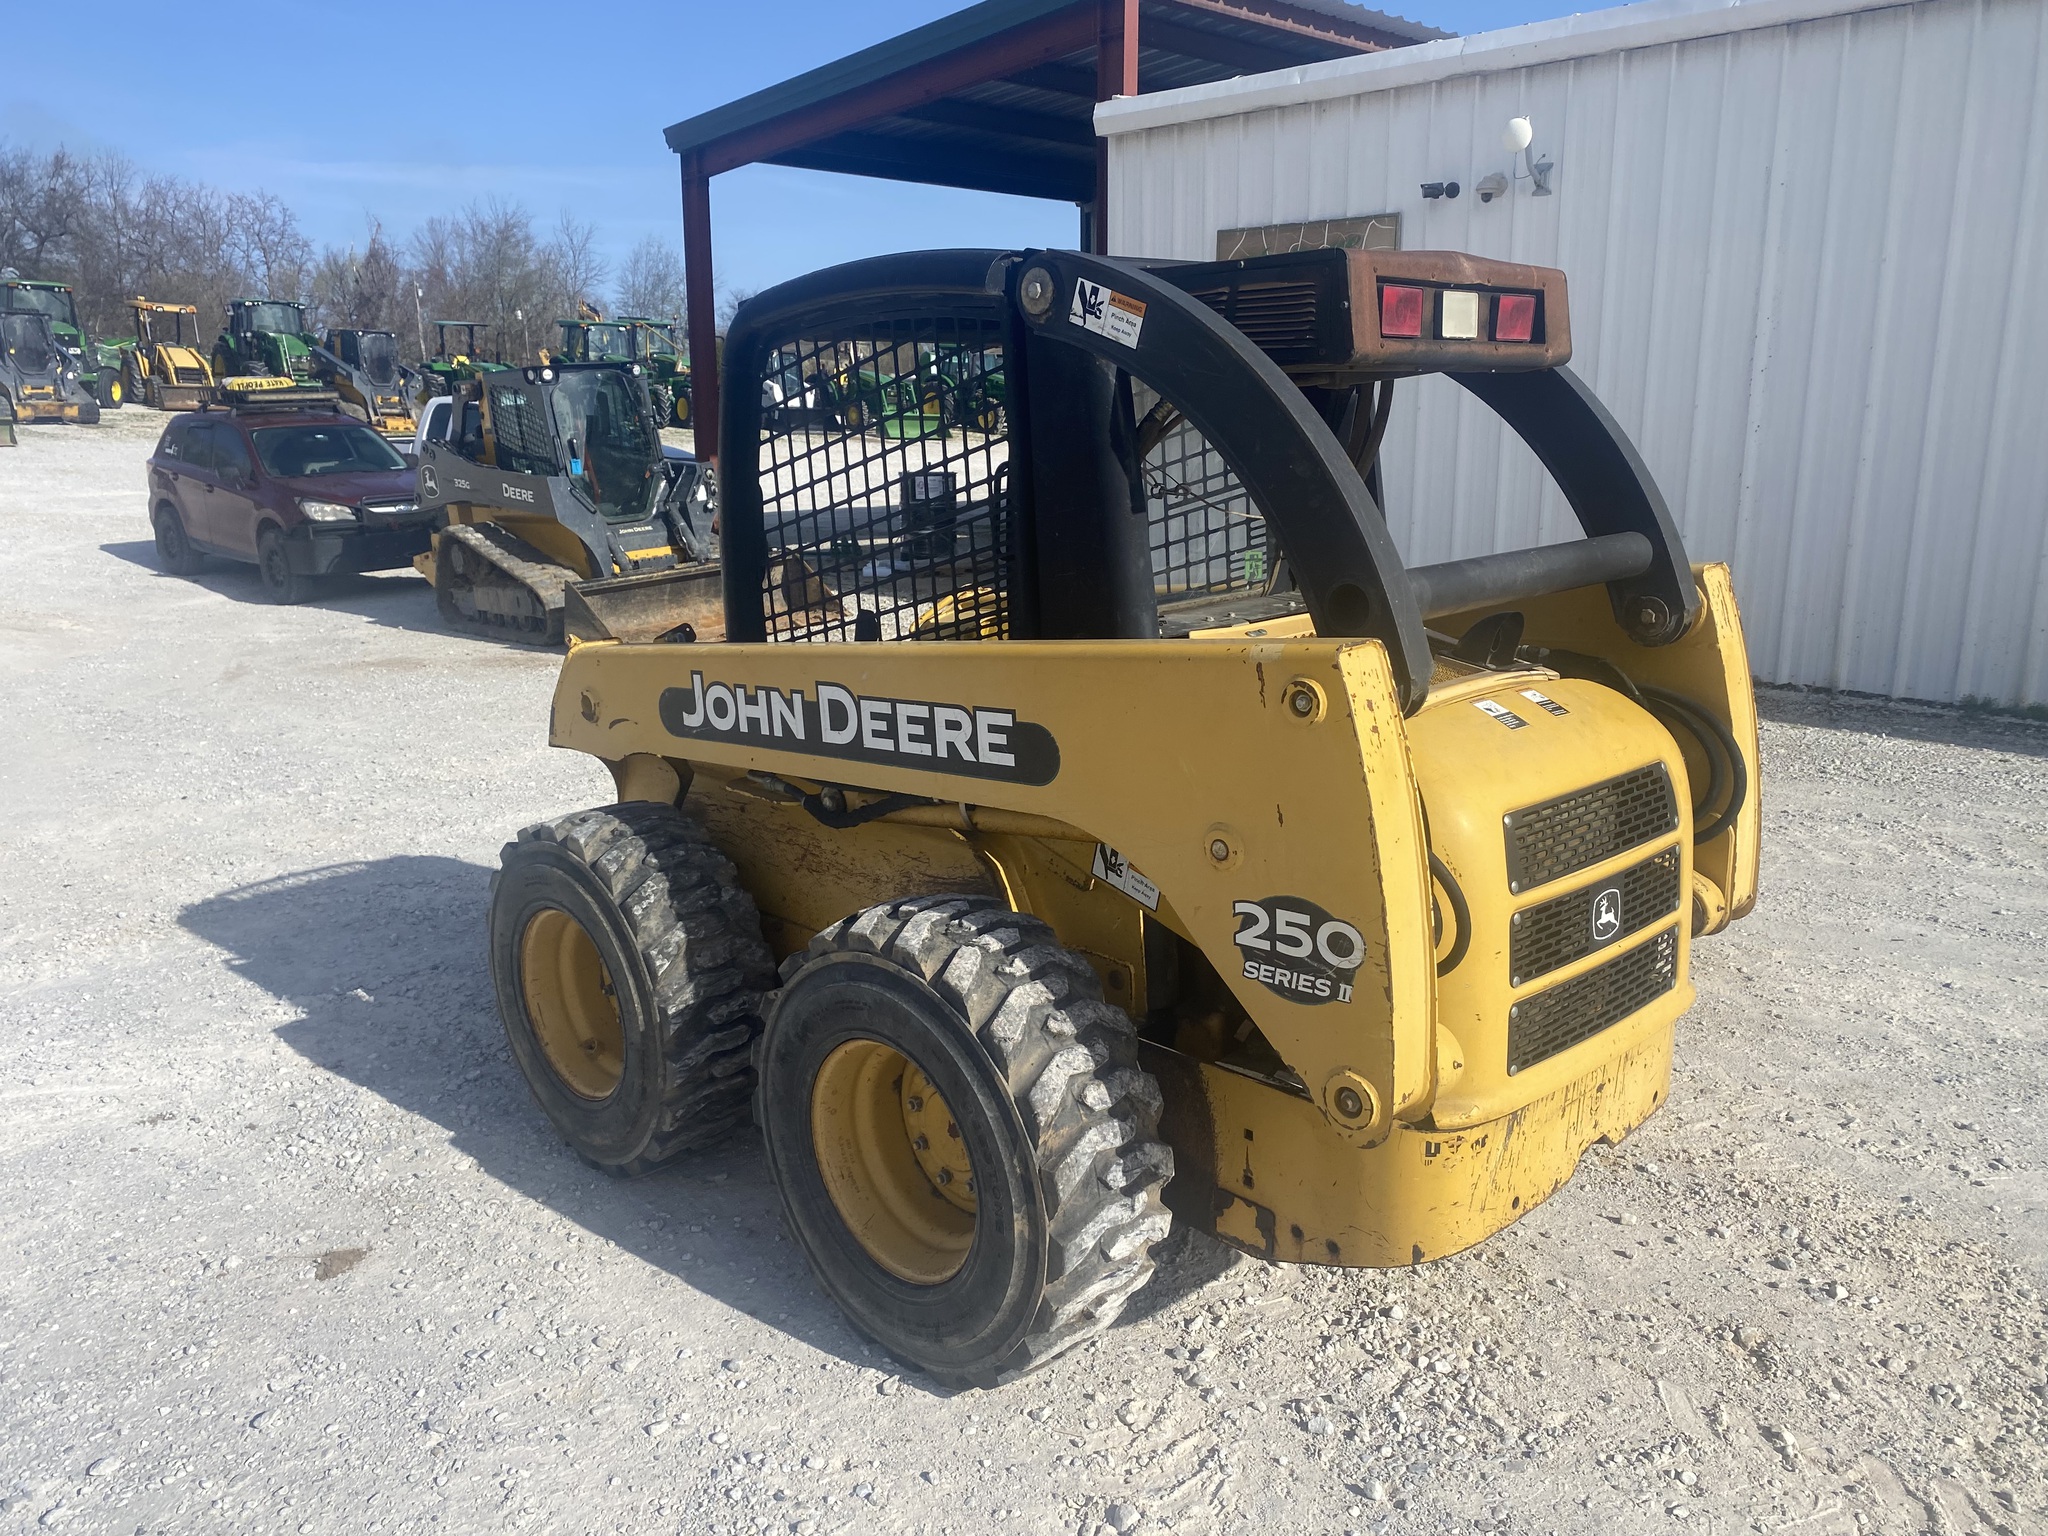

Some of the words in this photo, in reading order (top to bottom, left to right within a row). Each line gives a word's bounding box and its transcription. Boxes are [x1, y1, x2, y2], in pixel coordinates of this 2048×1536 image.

[1117, 298, 1142, 312] WARNING
[1111, 312, 1124, 323] Pinch
[1125, 317, 1137, 327] Area
[1111, 325, 1121, 333] Keep
[1121, 328, 1132, 337] Away
[453, 478, 470, 489] 325G
[502, 483, 535, 503] DEERE
[619, 527, 635, 535] JOHN
[634, 525, 654, 533] DEERE
[682, 673, 805, 740] JOHN
[816, 684, 1016, 767] DEERE
[1131, 874, 1144, 886] Pinch
[1144, 883, 1155, 892] Area
[1234, 902, 1366, 969] 250
[1243, 961, 1332, 997] SERIES
[1336, 983, 1354, 1004] II
